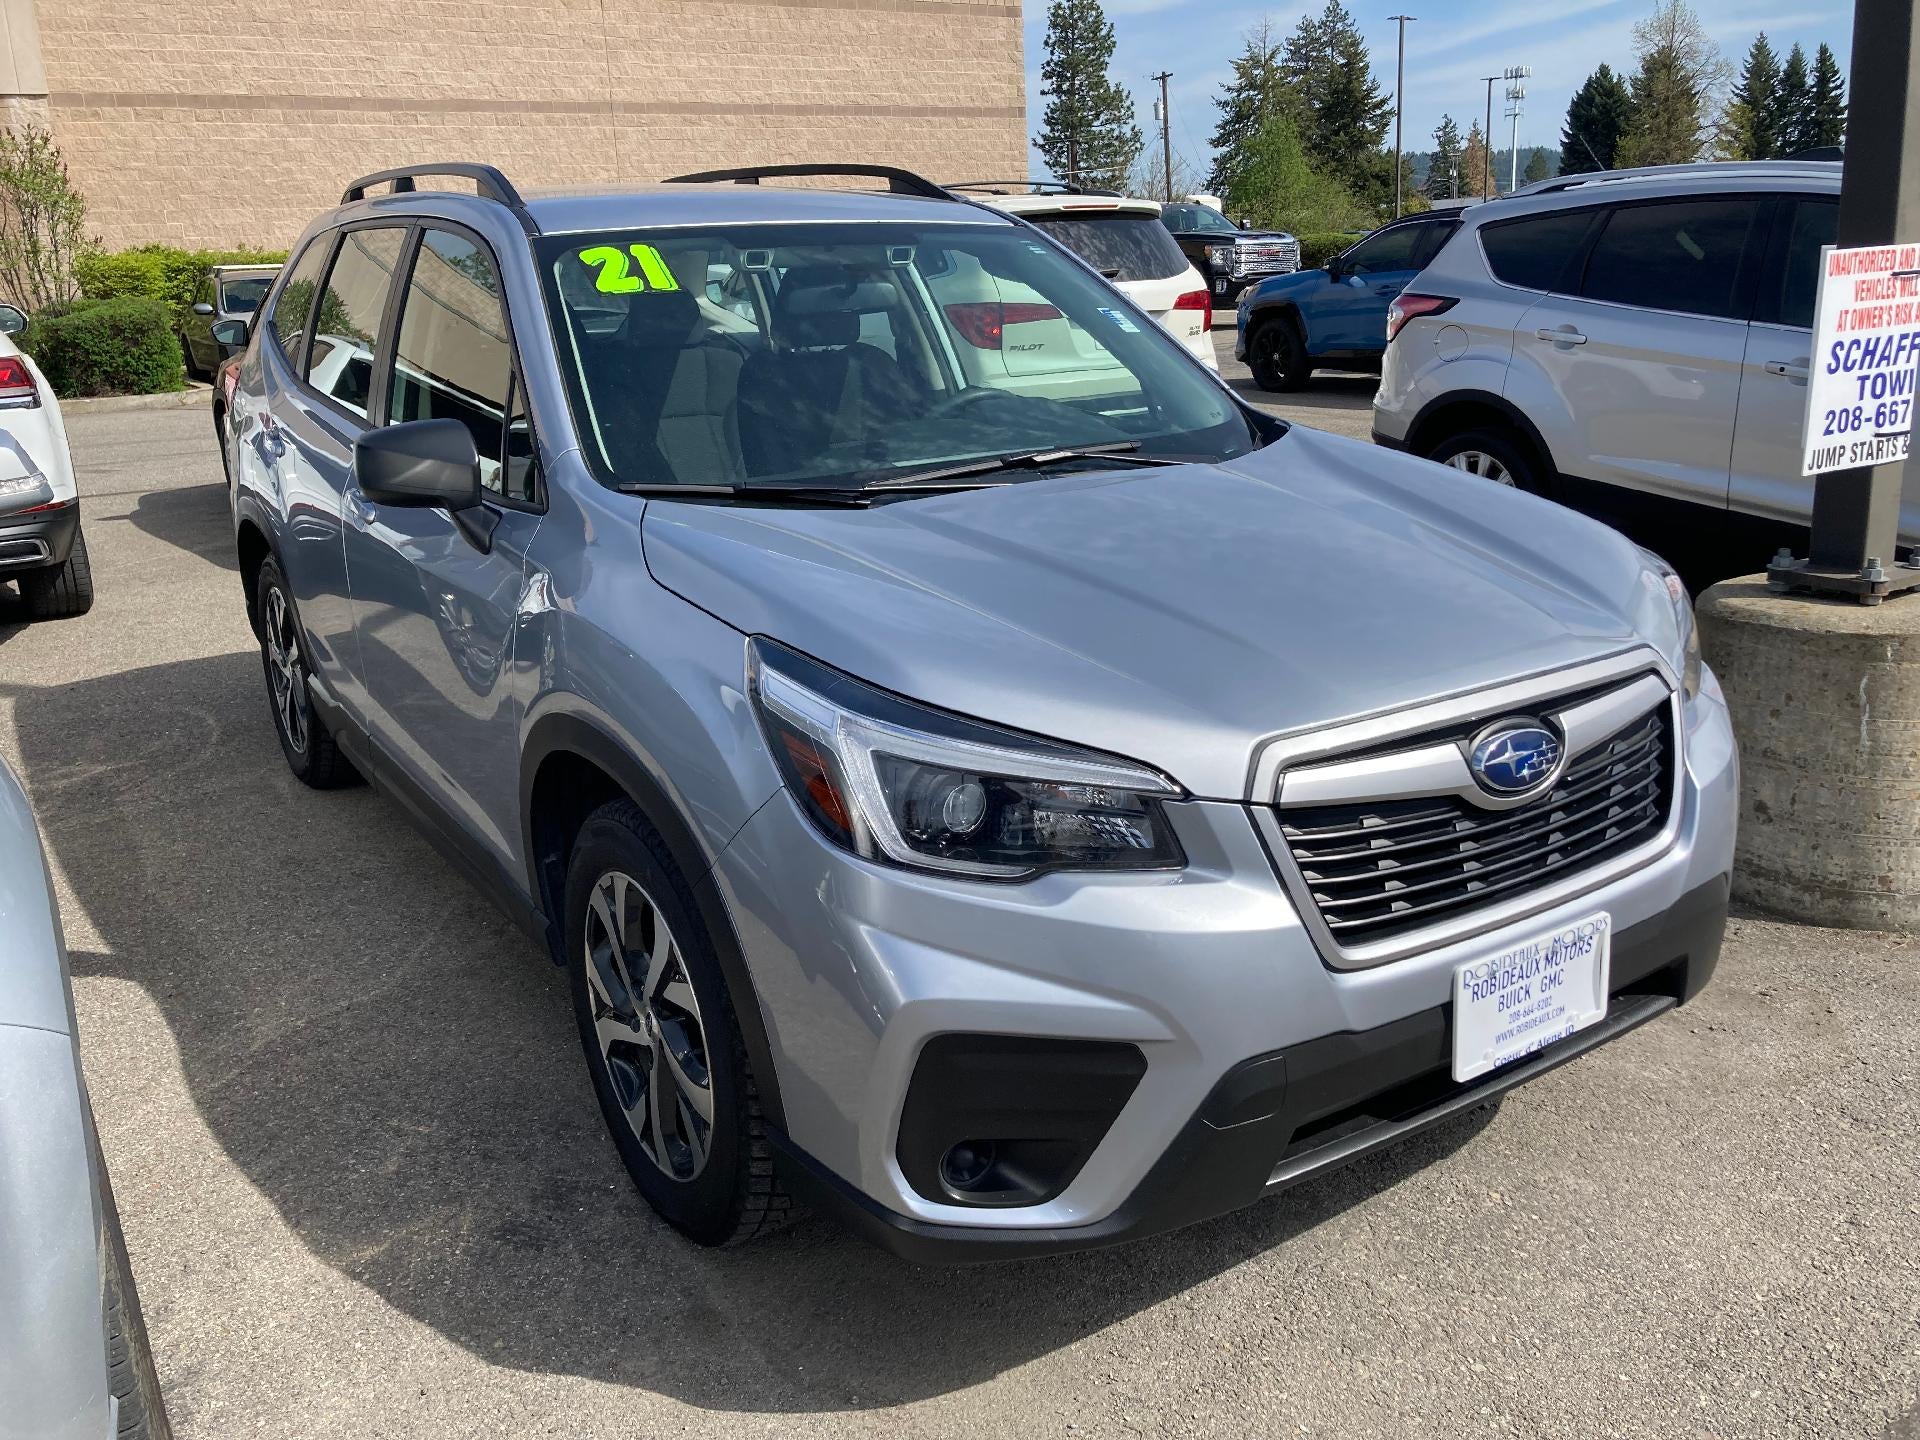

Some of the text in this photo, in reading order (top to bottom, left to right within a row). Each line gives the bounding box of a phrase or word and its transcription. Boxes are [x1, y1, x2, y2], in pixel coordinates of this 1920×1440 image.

[578, 244, 679, 293] 21
[1829, 250, 1897, 277] UNAUTHORIZED
[1898, 247, 1916, 271] AND
[1855, 275, 1919, 302] VEHICLES WILL
[1837, 310, 1849, 332] AT
[1850, 305, 1893, 330] OWNER'S
[1895, 302, 1914, 326] RISK
[1008, 343, 1045, 353] PILOT
[1827, 331, 1920, 375] SCHAFF
[1823, 398, 1911, 436] 208-667
[1808, 445, 1846, 471] JUMP
[1850, 436, 1899, 464] STARTS
[1463, 943, 1541, 990] ROBIDEAUX
[1472, 935, 1594, 1003] ROBIDEAUX MOTORS
[1498, 968, 1565, 1013] BUICK GMC
[1507, 995, 1552, 1025] 208-664-8202
